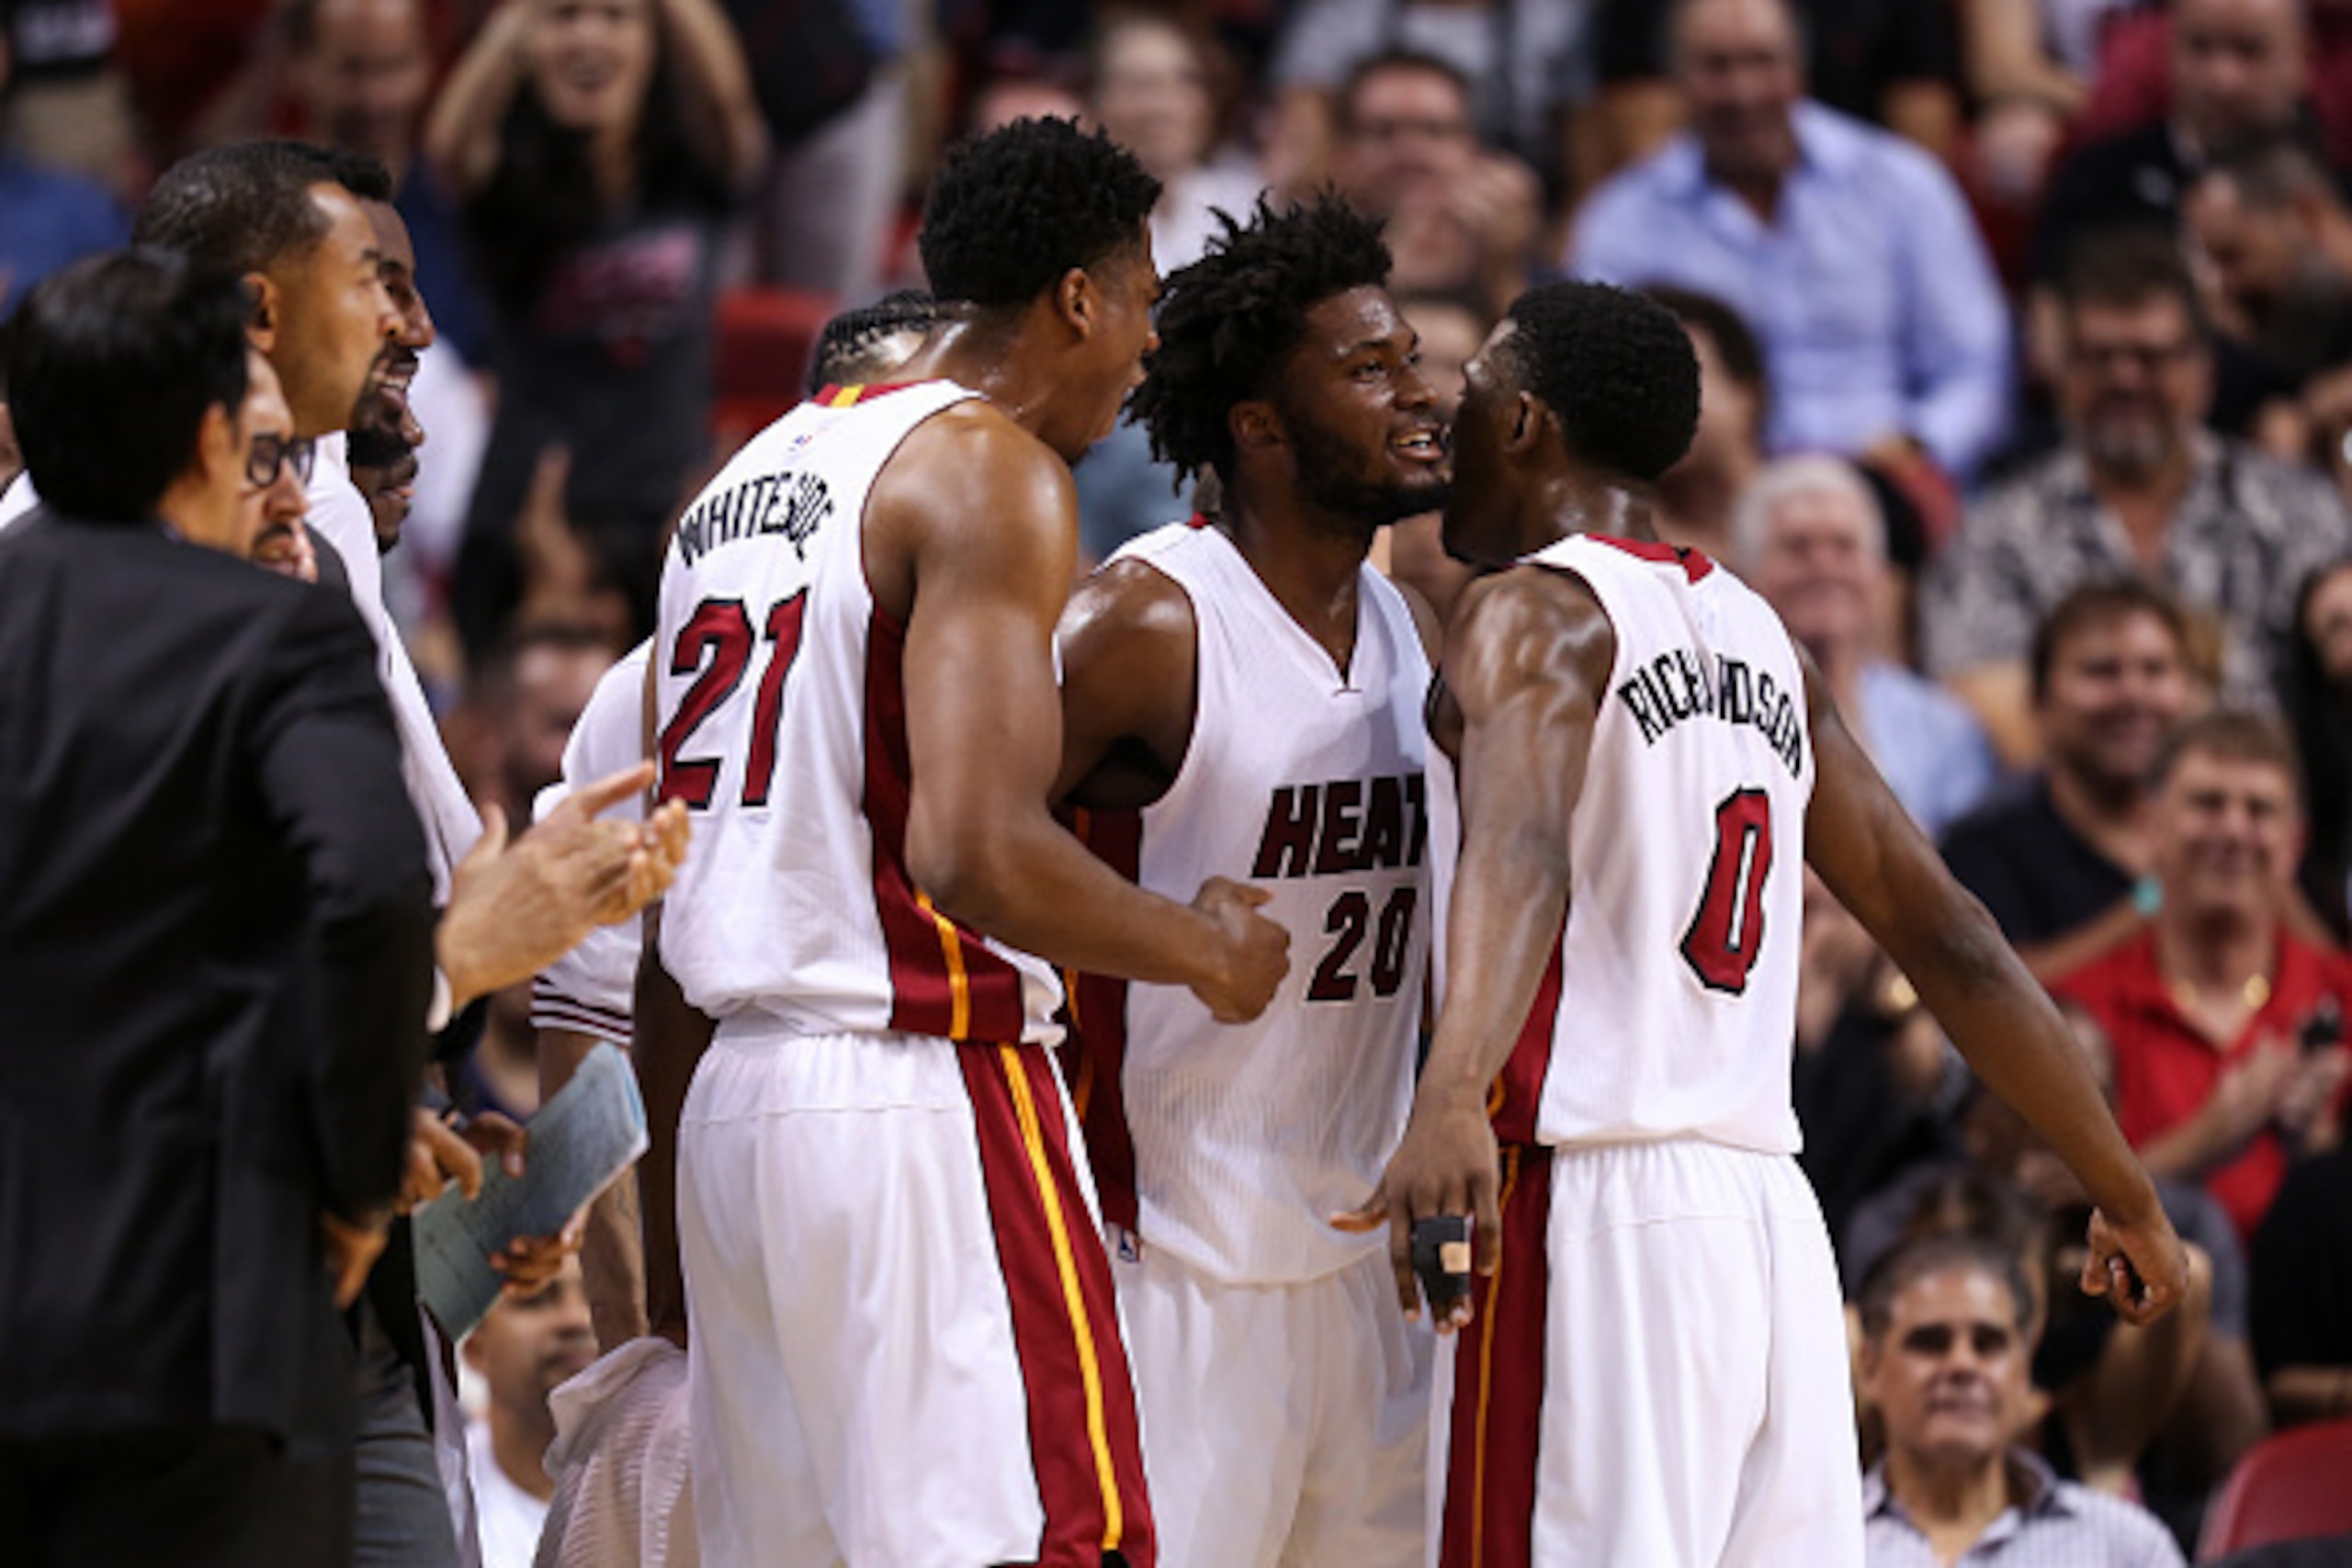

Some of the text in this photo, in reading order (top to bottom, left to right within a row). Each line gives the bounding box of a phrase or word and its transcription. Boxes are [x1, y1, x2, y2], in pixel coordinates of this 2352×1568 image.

[654, 586, 809, 810] 21
[1250, 772, 1428, 878] HEAT
[1679, 784, 1772, 997] 0
[1306, 887, 1417, 1001] 20
